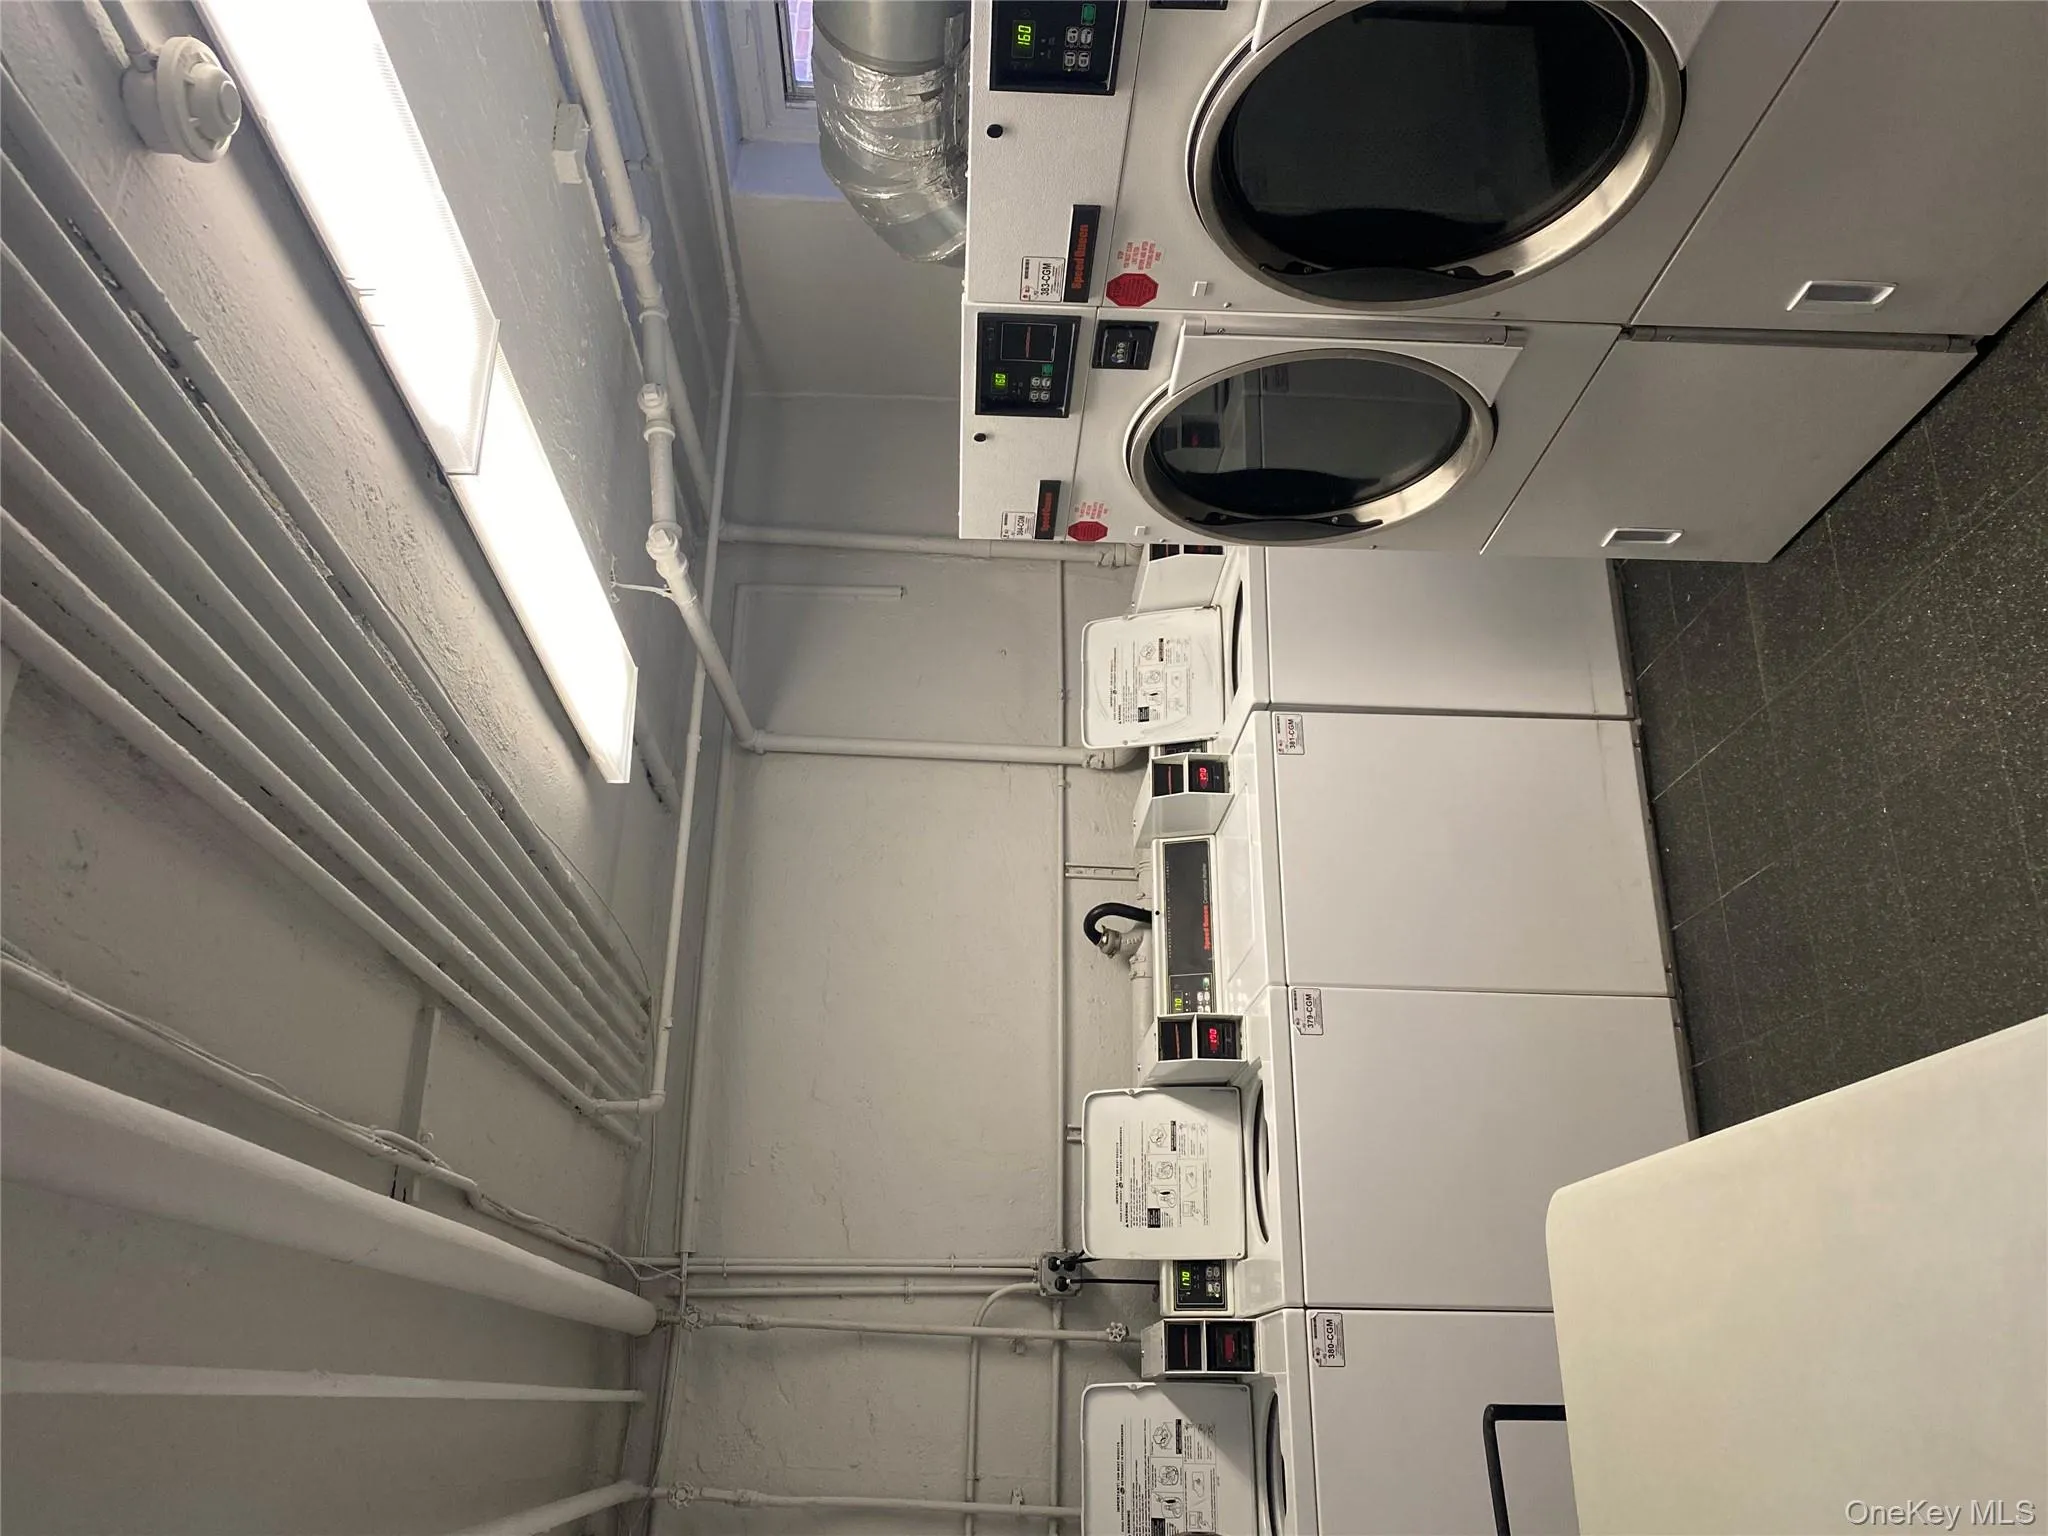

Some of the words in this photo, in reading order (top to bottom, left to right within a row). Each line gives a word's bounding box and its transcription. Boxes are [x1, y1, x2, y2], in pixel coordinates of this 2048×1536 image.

[1017, 24, 1032, 45] 160
[1073, 224, 1089, 257] Queen
[1040, 263, 1051, 296] 383-CGM
[1071, 258, 1085, 289] Speed
[994, 373, 1006, 386] 160
[1288, 719, 1296, 749] 381-CGM
[1203, 927, 1211, 951] Speed
[1174, 998, 1182, 1012] 170
[1305, 993, 1314, 1029] 379-CGM
[1182, 1271, 1190, 1287] 170
[1326, 1319, 1335, 1360] 380-CGM
